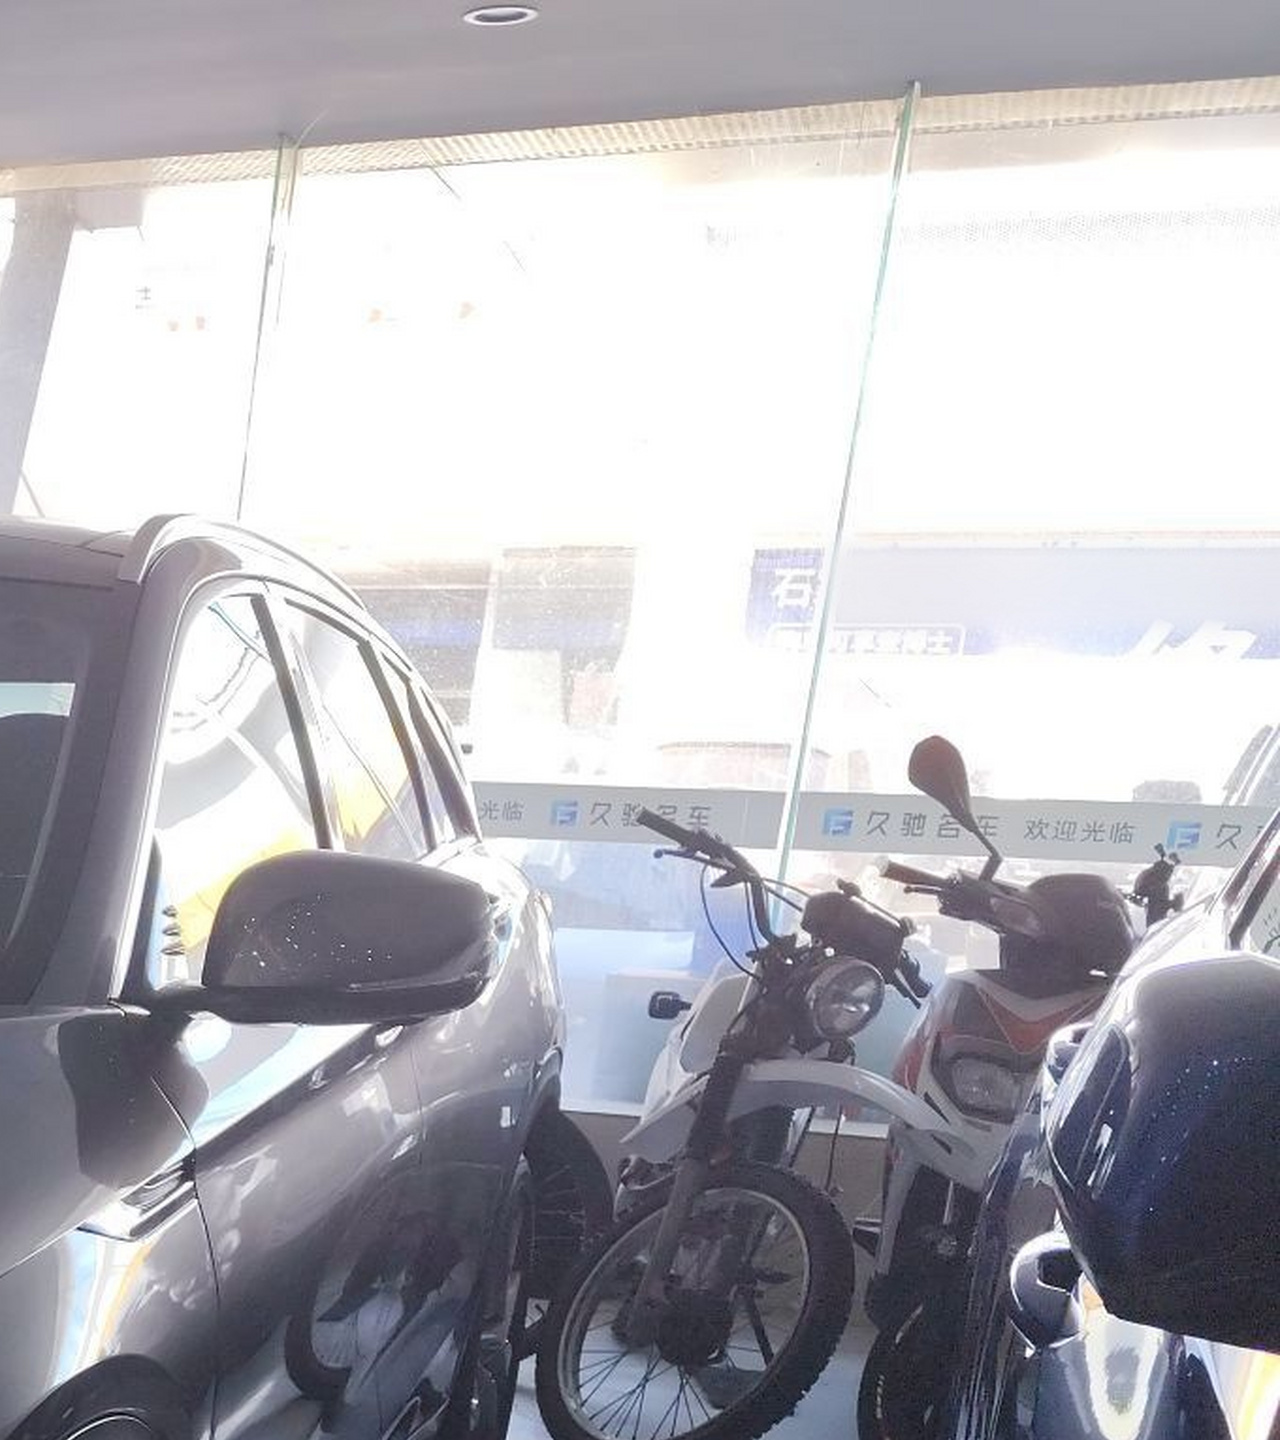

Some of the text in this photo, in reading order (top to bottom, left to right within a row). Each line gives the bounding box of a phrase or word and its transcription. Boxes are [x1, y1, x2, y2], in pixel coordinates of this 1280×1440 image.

[479, 799, 525, 822] 光临
[1024, 817, 1137, 845] 欢迎光临
